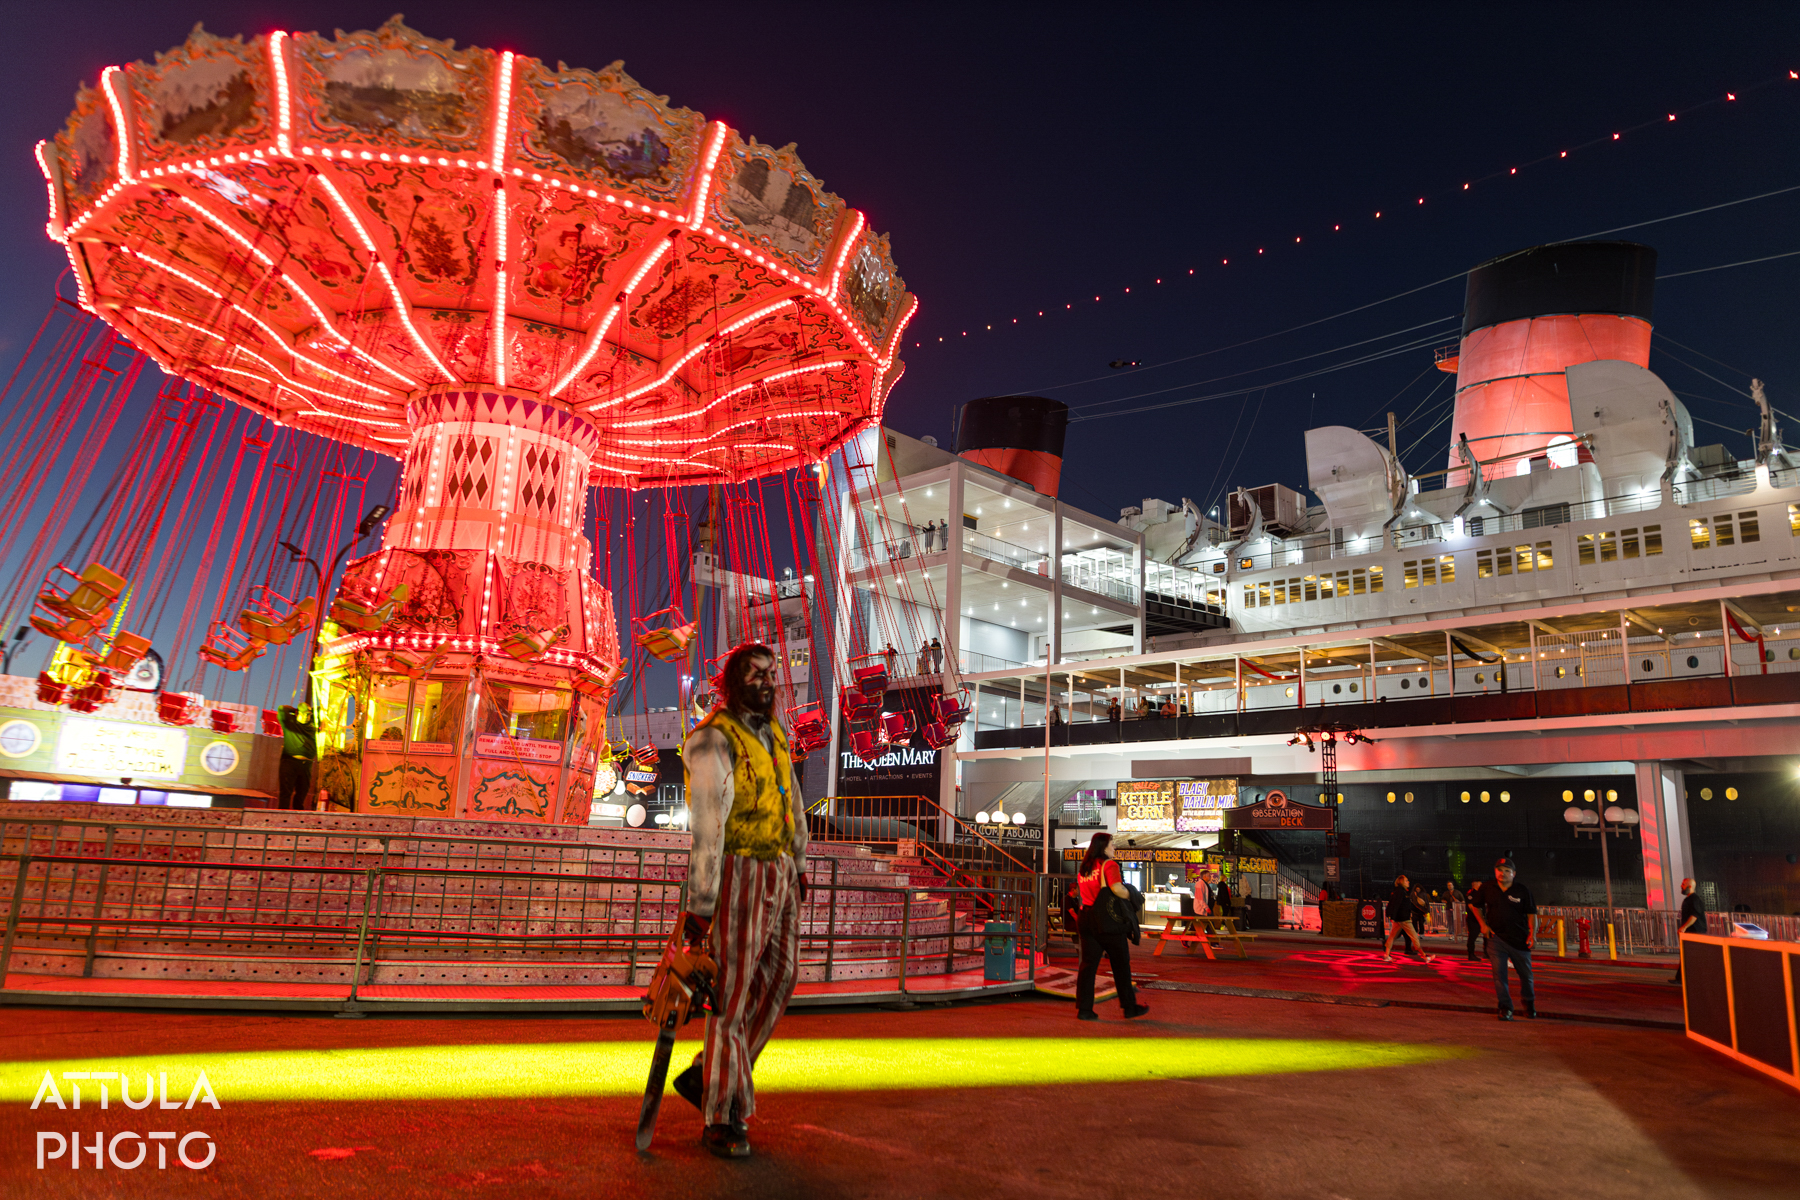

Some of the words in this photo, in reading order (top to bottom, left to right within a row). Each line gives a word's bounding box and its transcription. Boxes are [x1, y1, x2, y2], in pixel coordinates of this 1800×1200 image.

[123, 745, 166, 758] TYME
[841, 752, 863, 769] THE
[901, 748, 936, 766] MARY
[627, 772, 656, 782] SNICKERS
[869, 773, 904, 781] ATTRACTIONS
[1132, 781, 1161, 792] KILLER
[1179, 782, 1209, 796] BLACK
[1120, 791, 1171, 806] KETTLE
[1183, 795, 1215, 809] DAHLIA
[1217, 794, 1236, 808] MIX
[1127, 805, 1164, 820] CORN
[1252, 808, 1304, 818] OBSERVATION
[1280, 817, 1304, 826] DECK
[961, 823, 1004, 837] WELCOM
[1006, 828, 1041, 840] ABOARD
[1155, 850, 1182, 862] CHEESE
[1183, 850, 1204, 863] CORN
[1249, 857, 1276, 872] CORN
